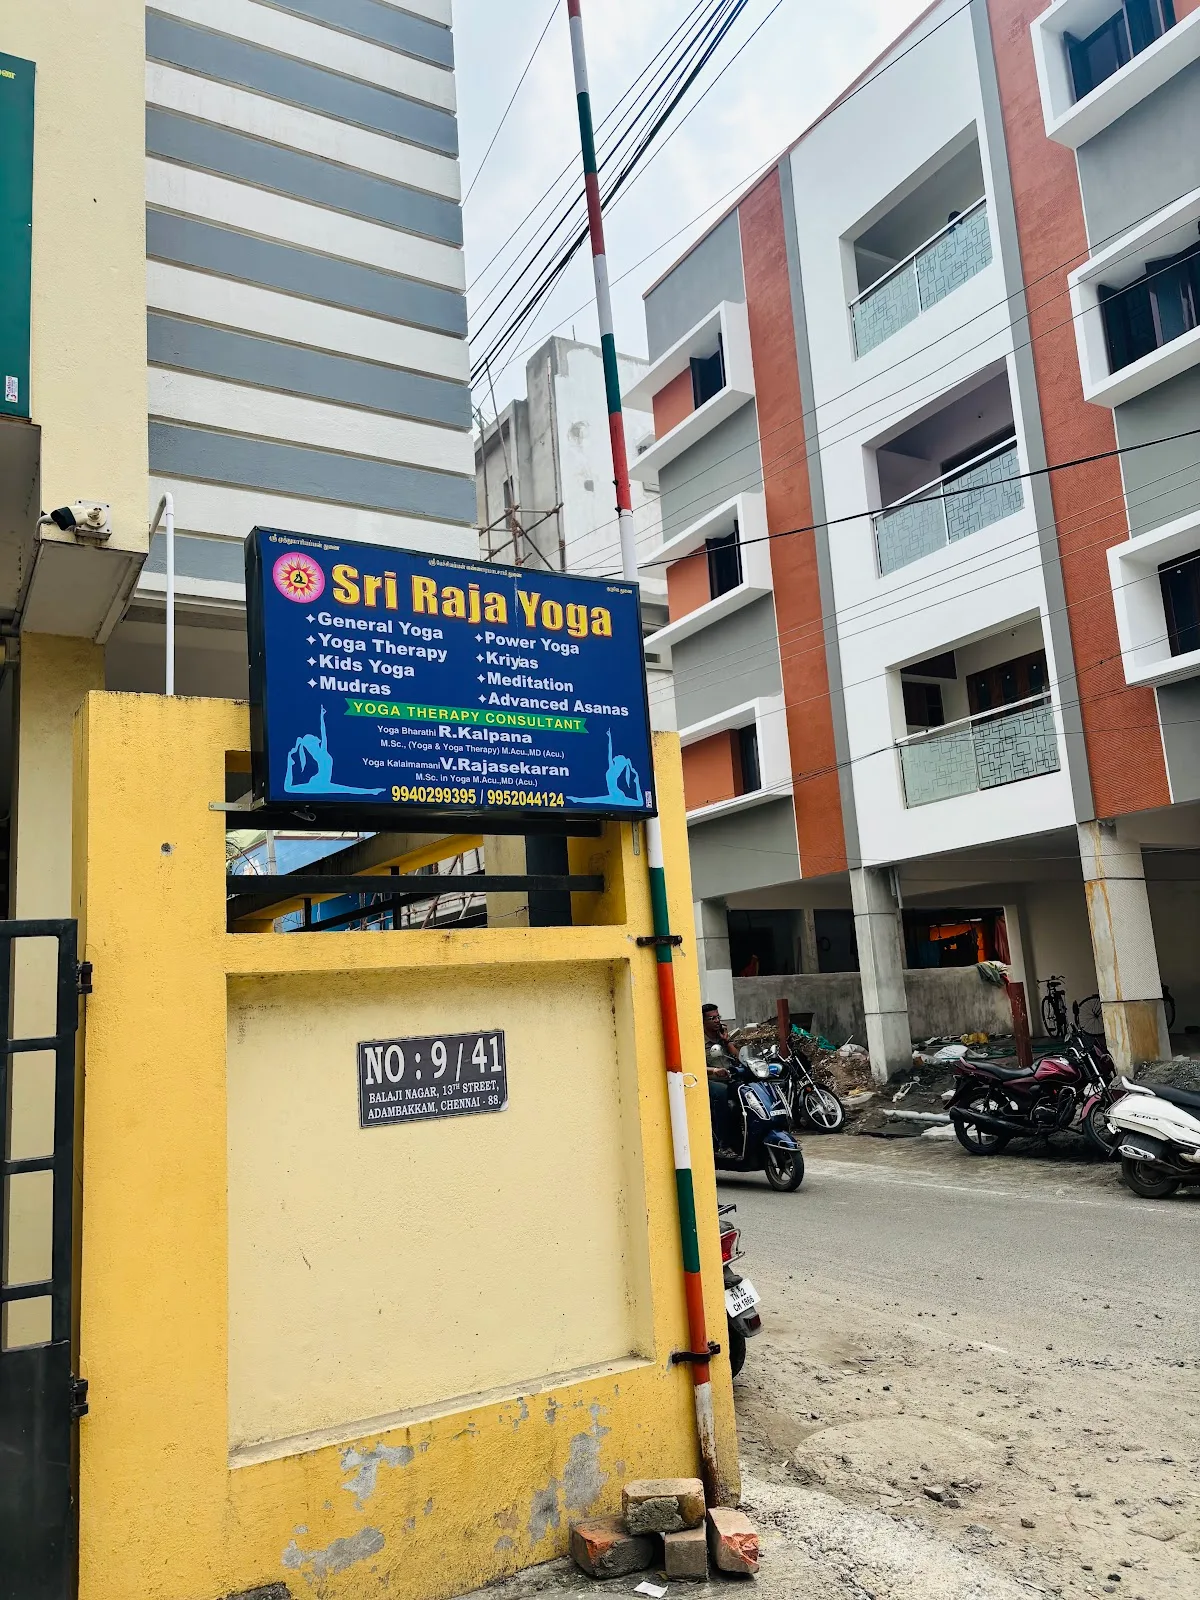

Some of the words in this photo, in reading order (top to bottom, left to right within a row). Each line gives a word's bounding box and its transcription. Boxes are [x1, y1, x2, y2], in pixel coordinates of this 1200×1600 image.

[332, 564, 398, 610] Sri
[411, 574, 508, 625] Raja
[516, 589, 613, 639] Yoga
[317, 611, 393, 634] General
[398, 620, 444, 642] Yoga
[317, 632, 367, 654] Yoga
[371, 638, 448, 663] Therapy
[484, 630, 537, 650] Power
[540, 637, 580, 657] Yoga
[319, 653, 363, 672] Kids
[367, 658, 415, 679] Yoga
[485, 651, 539, 670] Kriyas
[319, 675, 392, 696] Mudras
[487, 671, 574, 693] Meditation
[353, 701, 401, 717] YOGA
[406, 706, 480, 722] THERAPY
[485, 712, 582, 730] CONSULTANT
[488, 691, 569, 712] Advanced
[573, 699, 630, 717] Asanas
[377, 725, 400, 736] Yoga
[401, 726, 437, 737] Bharathi
[438, 724, 533, 744] R.Kalpana
[408, 740, 433, 751] (Yoga
[434, 742, 441, 751] &
[443, 743, 464, 753] Yoga
[465, 744, 500, 756] Therapy)
[542, 750, 565, 760] (Acu.)
[362, 757, 385, 769] Yoga
[387, 759, 440, 770] Kalaimamani
[440, 757, 570, 777] V.Rajasekaran
[415, 772, 439, 782] M.Sc.
[440, 773, 448, 782] in
[450, 774, 471, 785] Yoga
[515, 778, 538, 788] (Acu.)
[391, 785, 477, 804] 9940299395
[480, 788, 484, 805] /
[487, 789, 565, 807] 9952044124
[364, 1044, 405, 1085] NO
[415, 1052, 422, 1081] :
[430, 1040, 448, 1079] 9
[455, 1042, 464, 1082] /
[471, 1035, 502, 1074] 41
[368, 1090, 403, 1104] BALAJI
[405, 1086, 440, 1100] NAGAR,
[462, 1080, 500, 1093] STREET,
[367, 1102, 438, 1120] ADAMBAKKAM,
[440, 1097, 481, 1111] CHENNAI
[487, 1095, 502, 1106] 88.
[733, 1301, 742, 1311] CH
